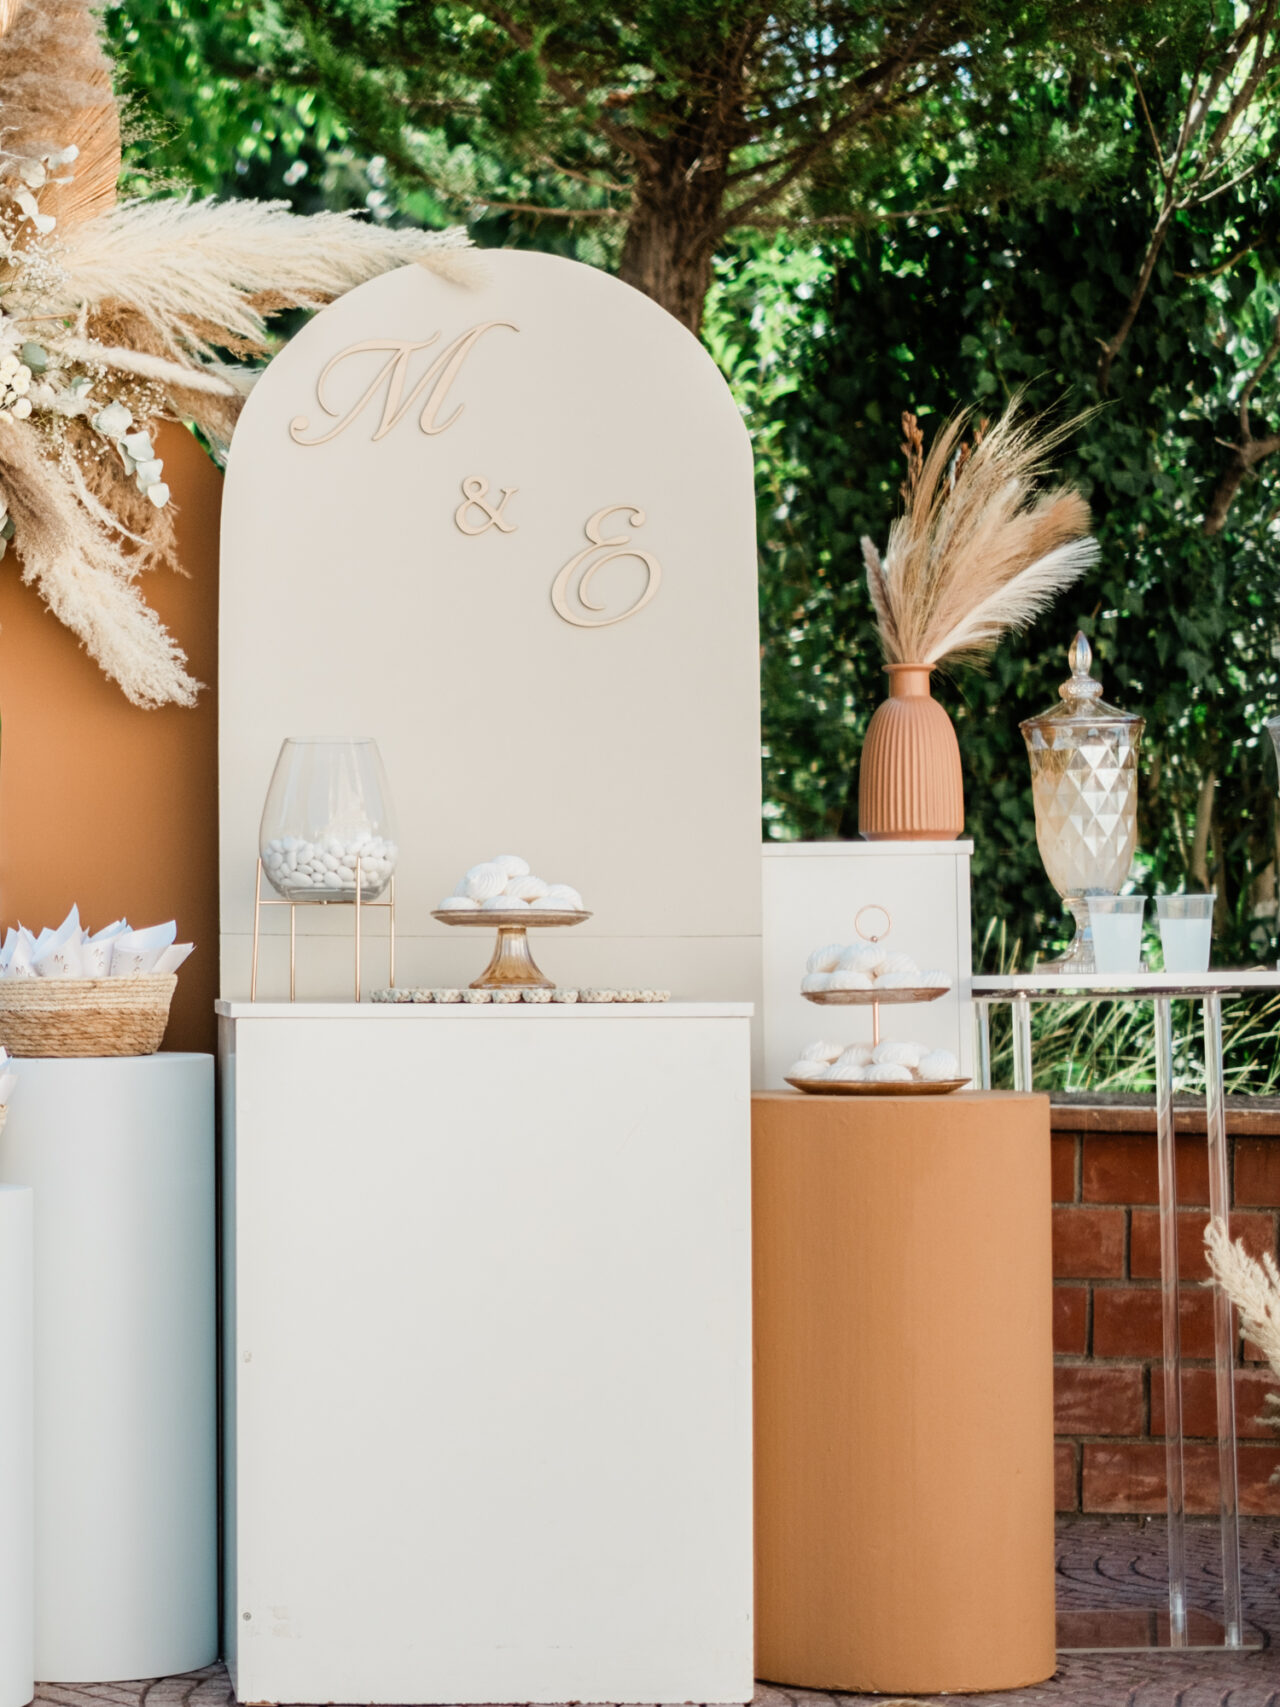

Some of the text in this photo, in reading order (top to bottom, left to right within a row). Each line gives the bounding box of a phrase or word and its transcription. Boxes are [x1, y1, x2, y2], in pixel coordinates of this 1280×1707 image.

[289, 321, 520, 446] M
[454, 475, 519, 536] &
[551, 504, 662, 628] E
